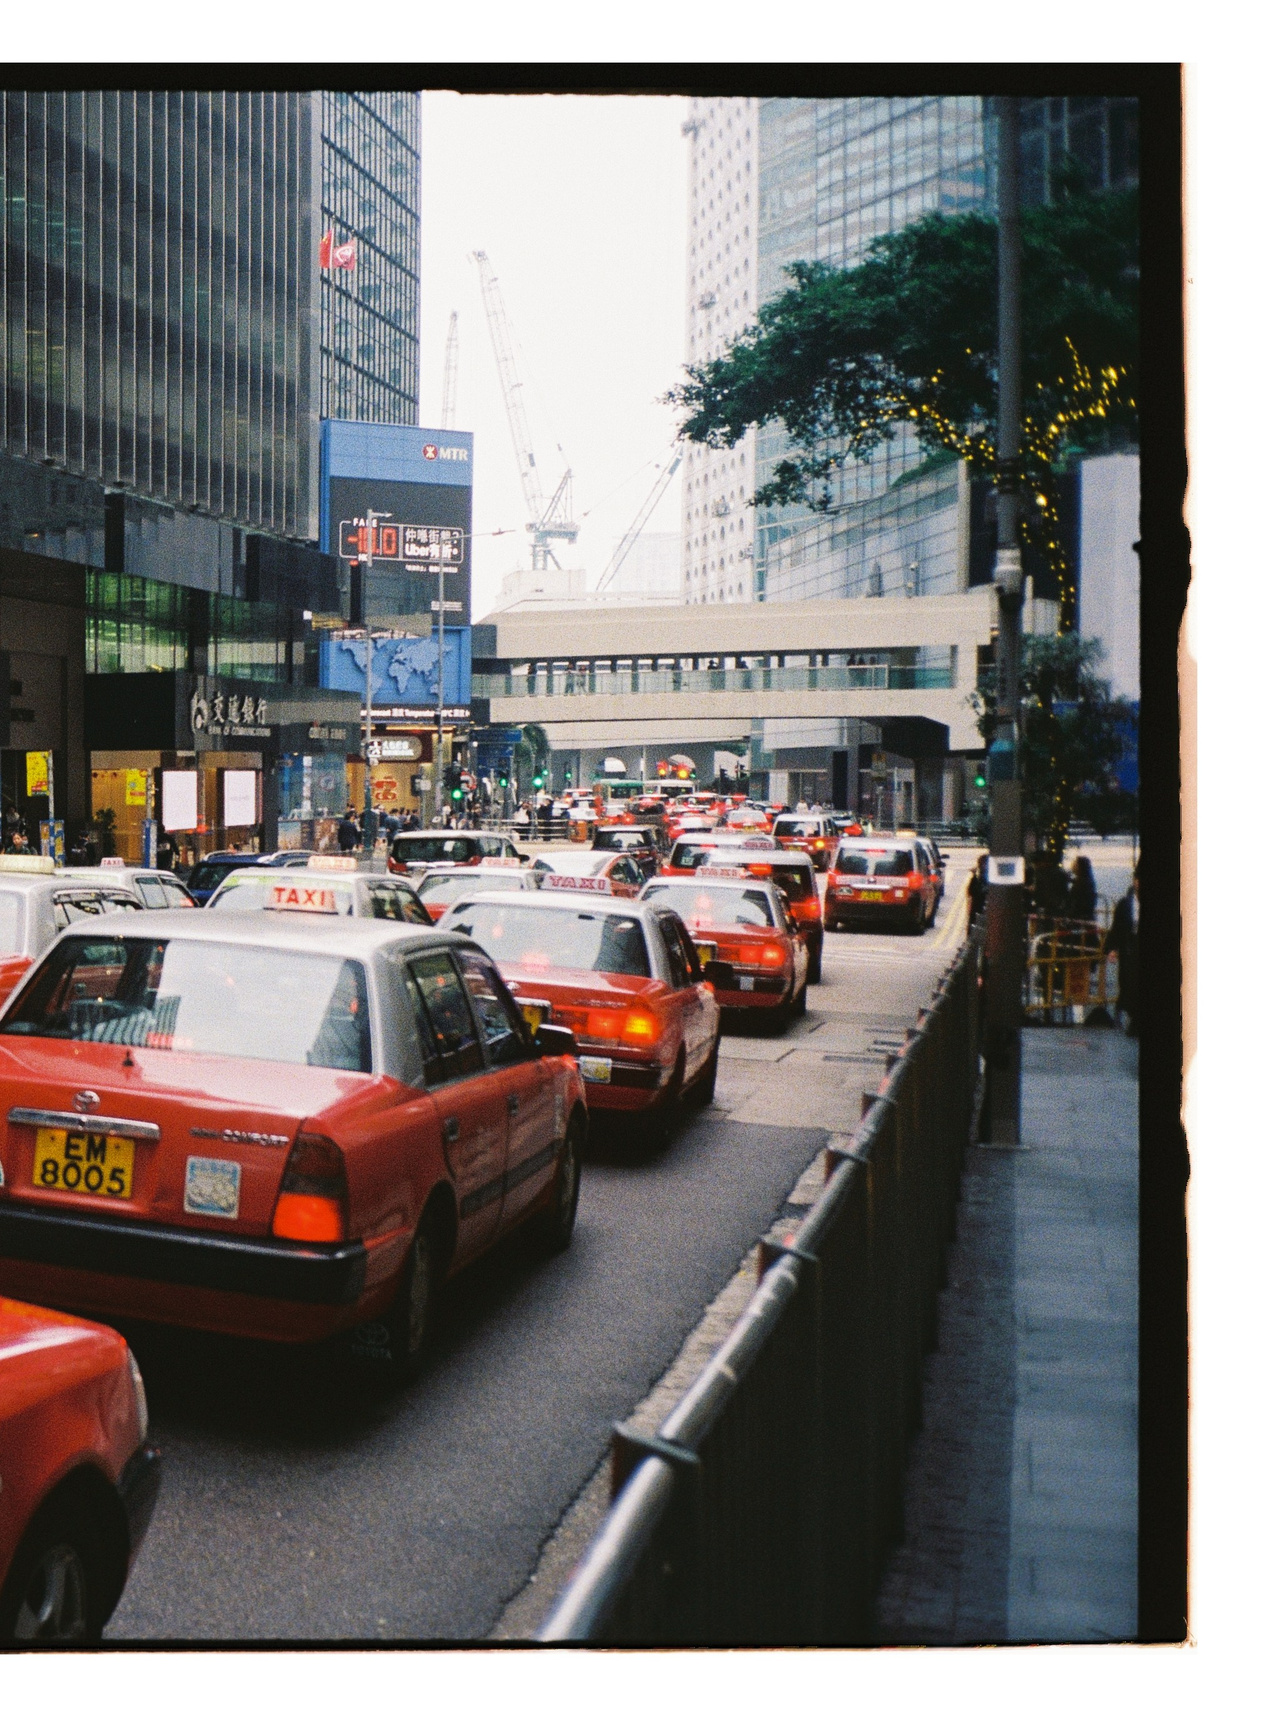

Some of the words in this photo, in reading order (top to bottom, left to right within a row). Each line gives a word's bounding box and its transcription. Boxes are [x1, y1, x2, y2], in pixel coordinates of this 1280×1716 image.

[439, 447, 468, 461] MTR
[353, 517, 378, 528] FAE
[214, 690, 267, 725] 交通銀行
[549, 875, 607, 891] TAXI
[273, 886, 326, 906] TAXI
[65, 1133, 107, 1163] EM
[40, 1158, 125, 1195] 8005
